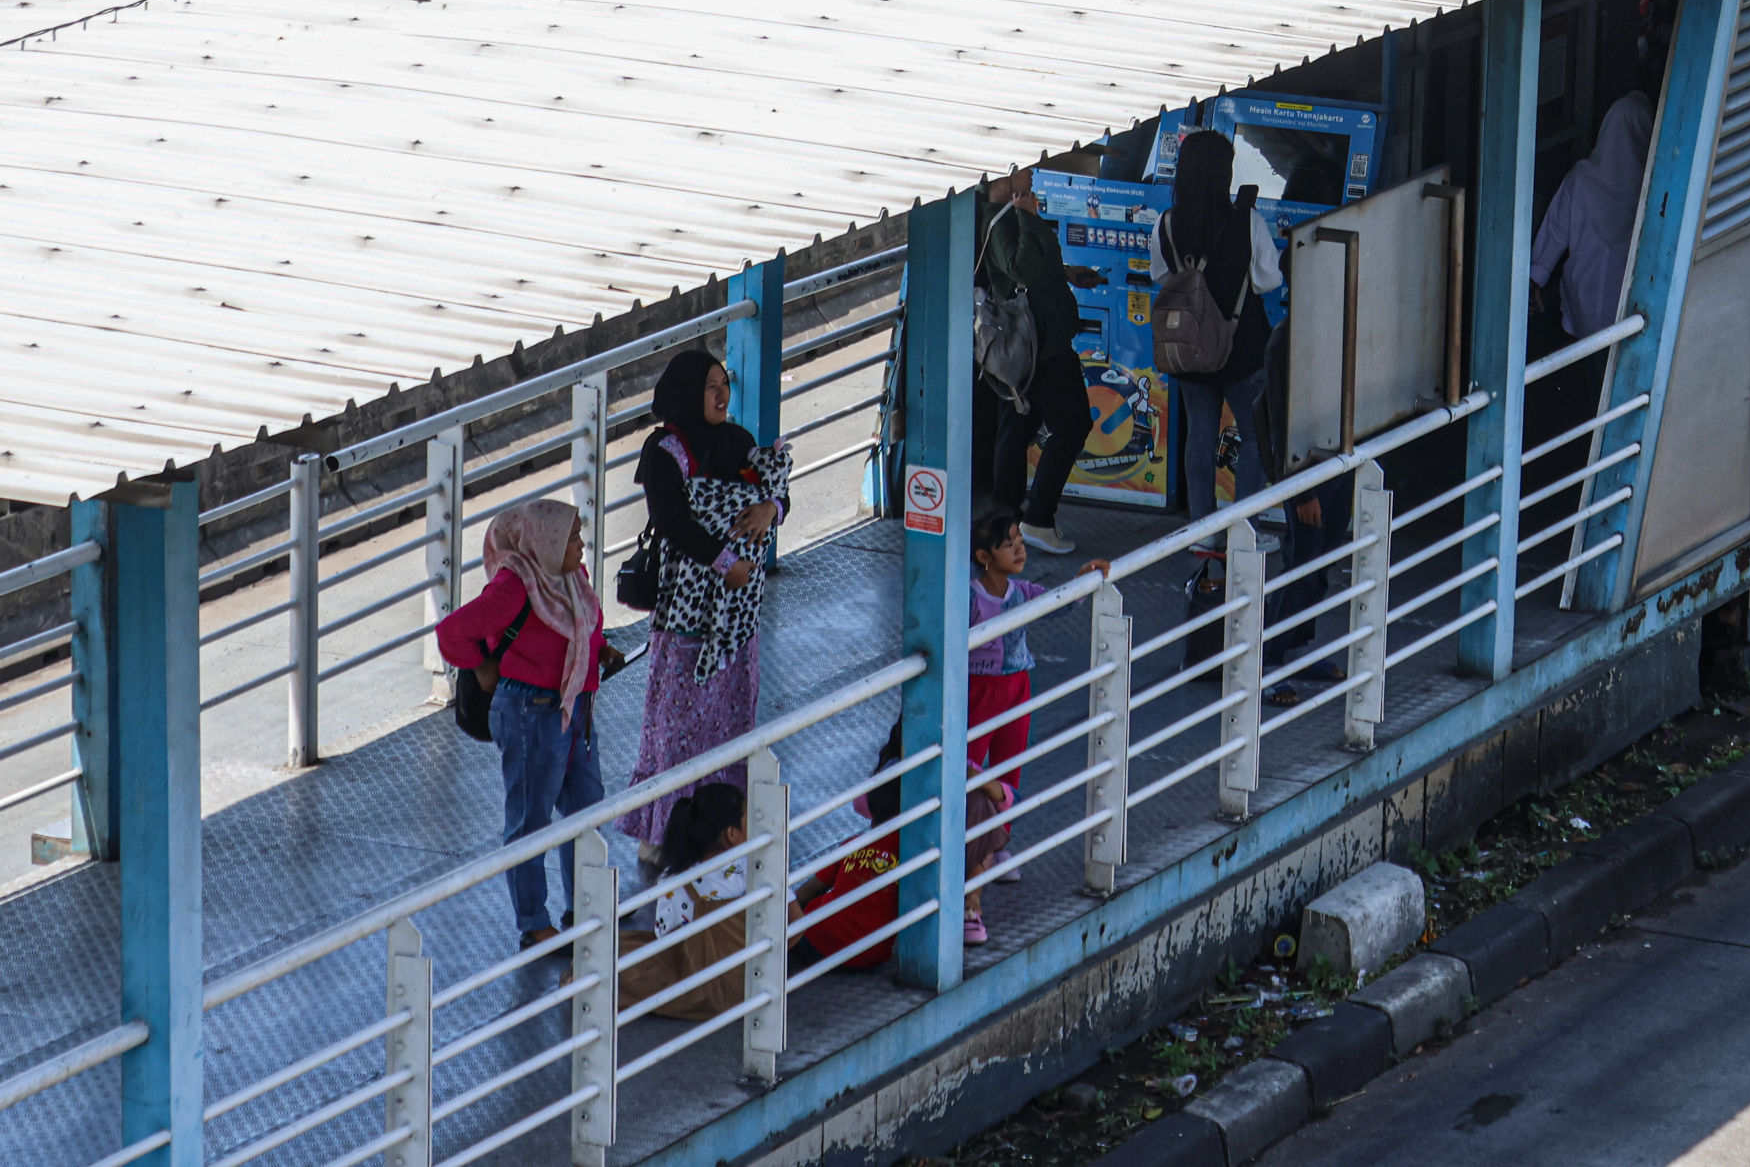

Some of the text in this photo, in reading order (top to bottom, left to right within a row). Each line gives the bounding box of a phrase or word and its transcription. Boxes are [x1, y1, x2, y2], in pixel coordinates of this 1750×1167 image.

[1249, 106, 1272, 114] Mesin
[1274, 109, 1295, 117] Kartu
[1297, 111, 1344, 122] Transjakarta
